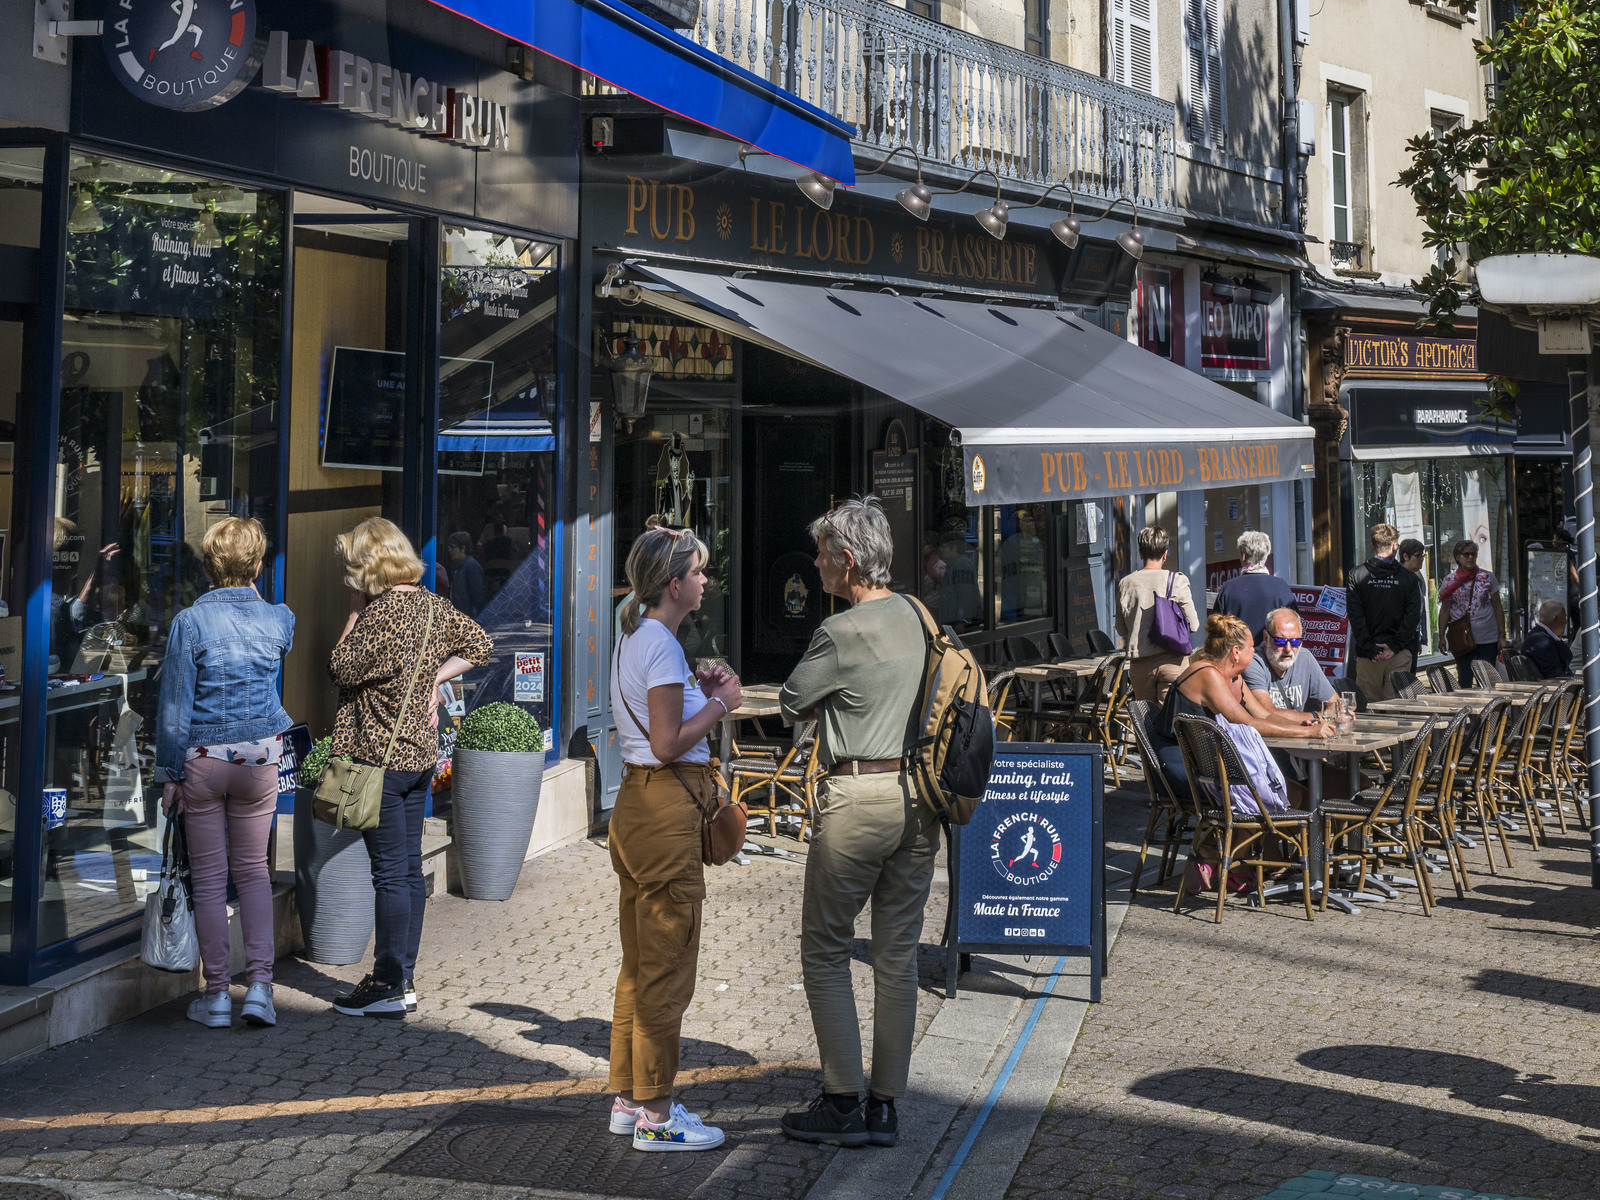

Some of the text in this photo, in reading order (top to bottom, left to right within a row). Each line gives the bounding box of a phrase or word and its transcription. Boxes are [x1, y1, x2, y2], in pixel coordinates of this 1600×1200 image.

[115, 18, 130, 49] LA
[142, 46, 238, 96] BOUTIQUE
[263, 31, 510, 150] LA FRENCH RUN
[349, 145, 428, 194] BOUTIQUE
[160, 217, 176, 230] Votre
[623, 174, 1039, 287] PUB LE LORD BRASSERIE
[152, 232, 192, 260] Running,
[162, 263, 200, 288] et fitness
[483, 302, 520, 319] Made in France
[1147, 284, 1166, 342] N
[1201, 299, 1264, 342] NEO VAPO
[1349, 337, 1409, 367] VICTOR'S
[1414, 409, 1468, 424] PARAPHARMACIE
[1040, 451, 1088, 492] PUB
[1103, 450, 1132, 489] LE
[1133, 448, 1184, 487] LORD
[1197, 444, 1280, 482] BRASSERIE
[1292, 592, 1315, 604] NEO
[516, 656, 541, 669] petit
[521, 664, 542, 675] futé
[516, 681, 542, 691] 2024
[1016, 759, 1065, 770] spécialiste
[988, 772, 1075, 789] unning, trail,
[982, 789, 1071, 804] fitness et lifestyle
[990, 812, 1061, 859] LA FRENCH RUN
[1006, 861, 1059, 886] BOUTIQUE
[973, 902, 1061, 918] Made in France
